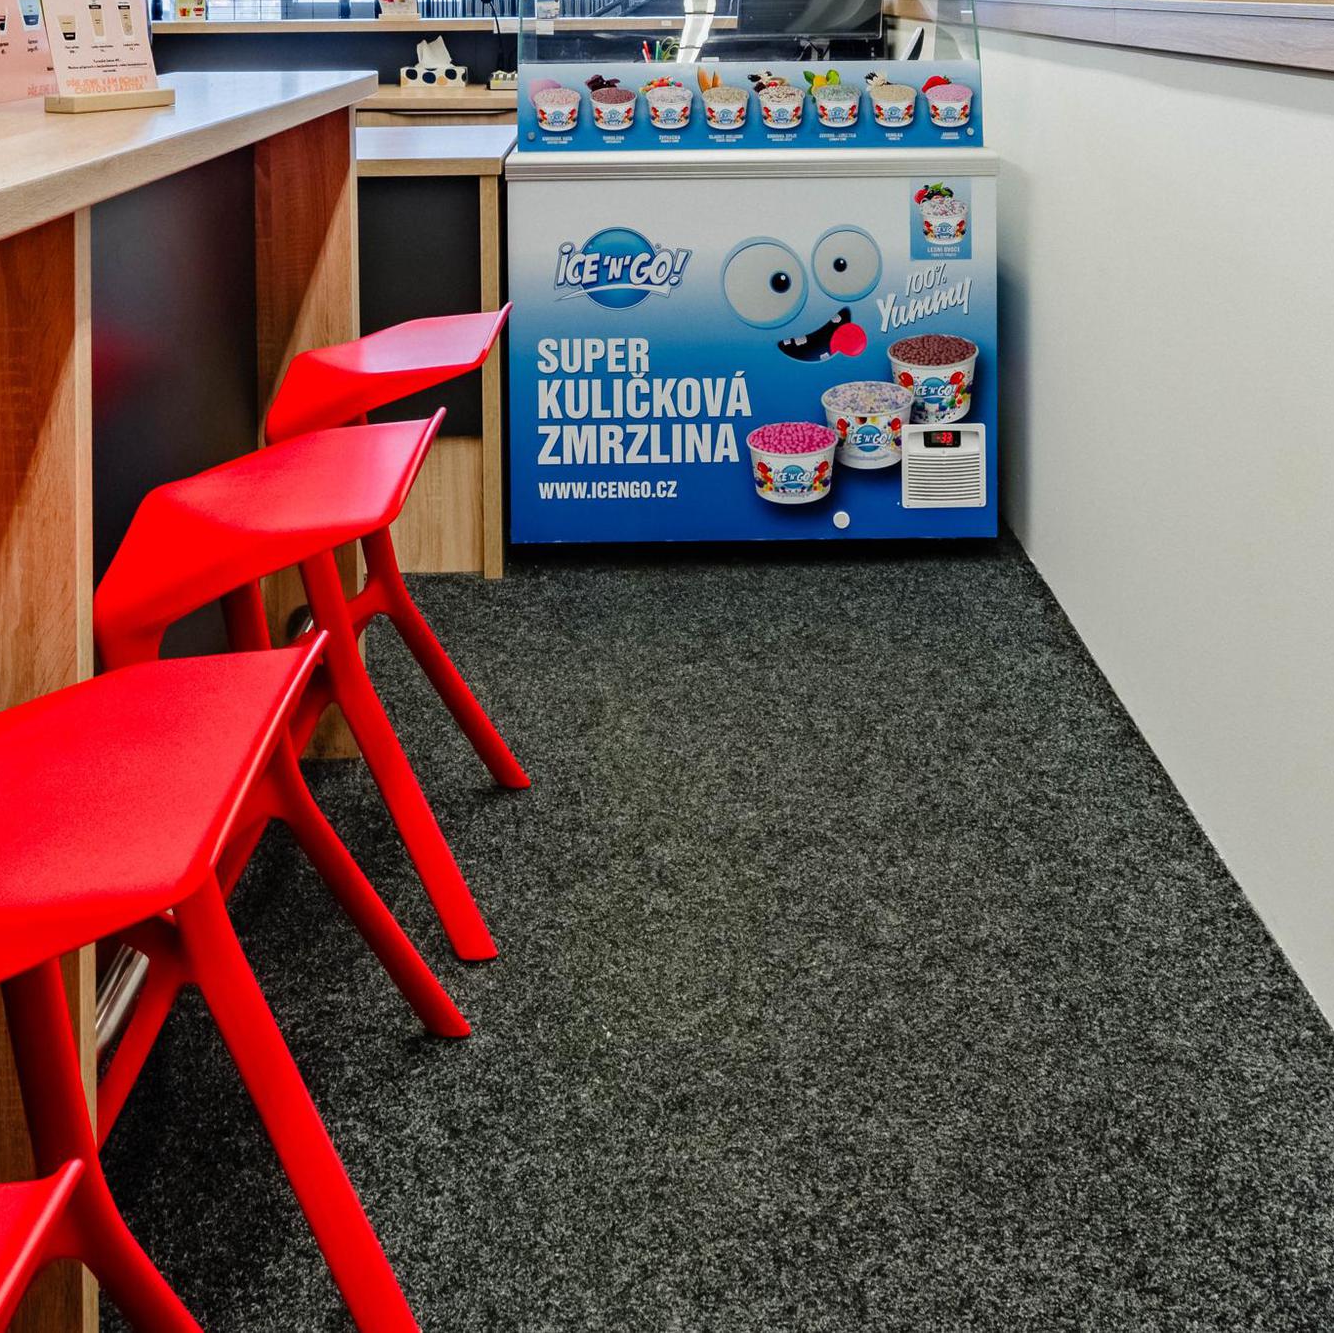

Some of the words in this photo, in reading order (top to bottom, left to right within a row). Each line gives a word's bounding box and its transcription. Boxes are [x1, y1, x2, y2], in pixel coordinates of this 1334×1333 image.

[905, 263, 948, 298] 100%
[875, 274, 973, 336] Yummy
[537, 337, 650, 374] SUPER
[538, 370, 752, 420] KULIČKOVÁ
[537, 422, 740, 466] ZMRZLINA
[538, 480, 679, 501] WWW.ICENGO.CZ
